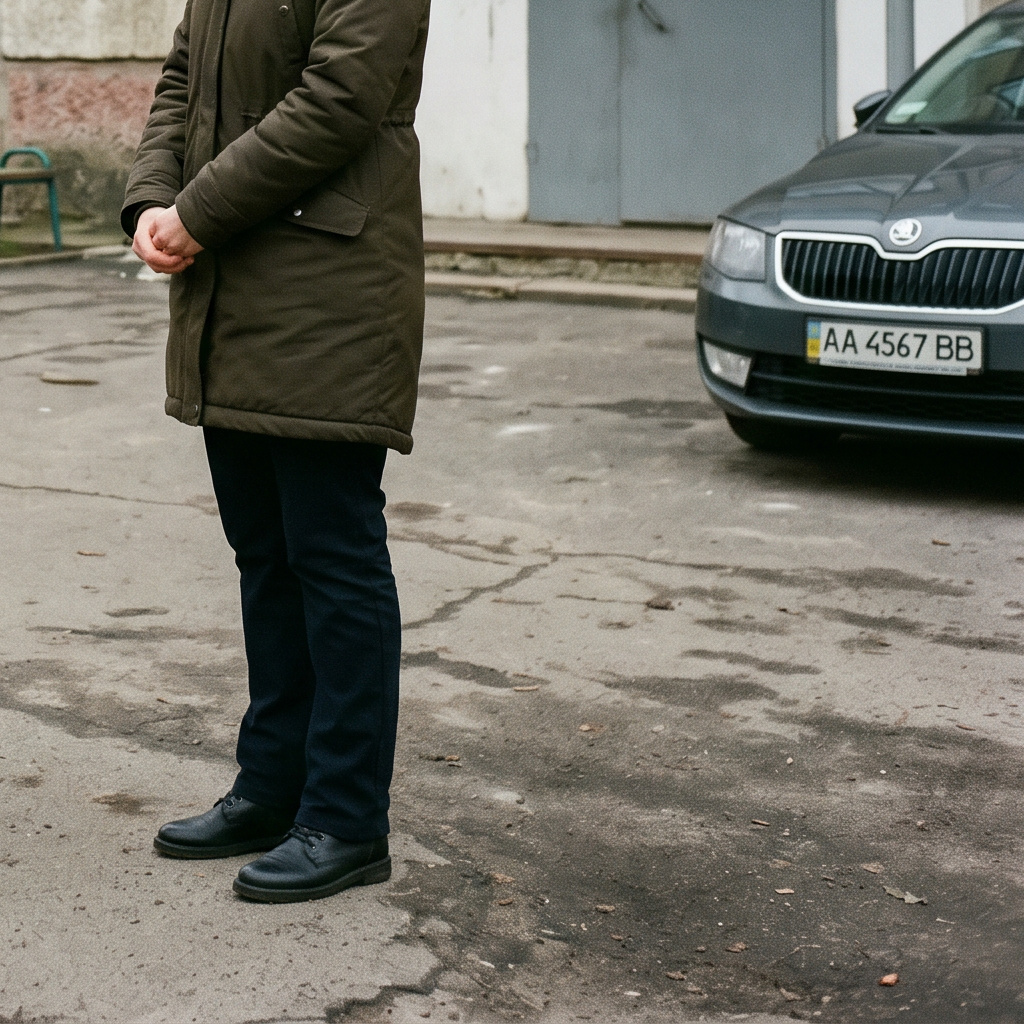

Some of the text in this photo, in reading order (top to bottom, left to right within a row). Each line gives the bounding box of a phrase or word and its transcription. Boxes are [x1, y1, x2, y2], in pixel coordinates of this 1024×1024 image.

[824, 327, 974, 362] AA 4567 BB
